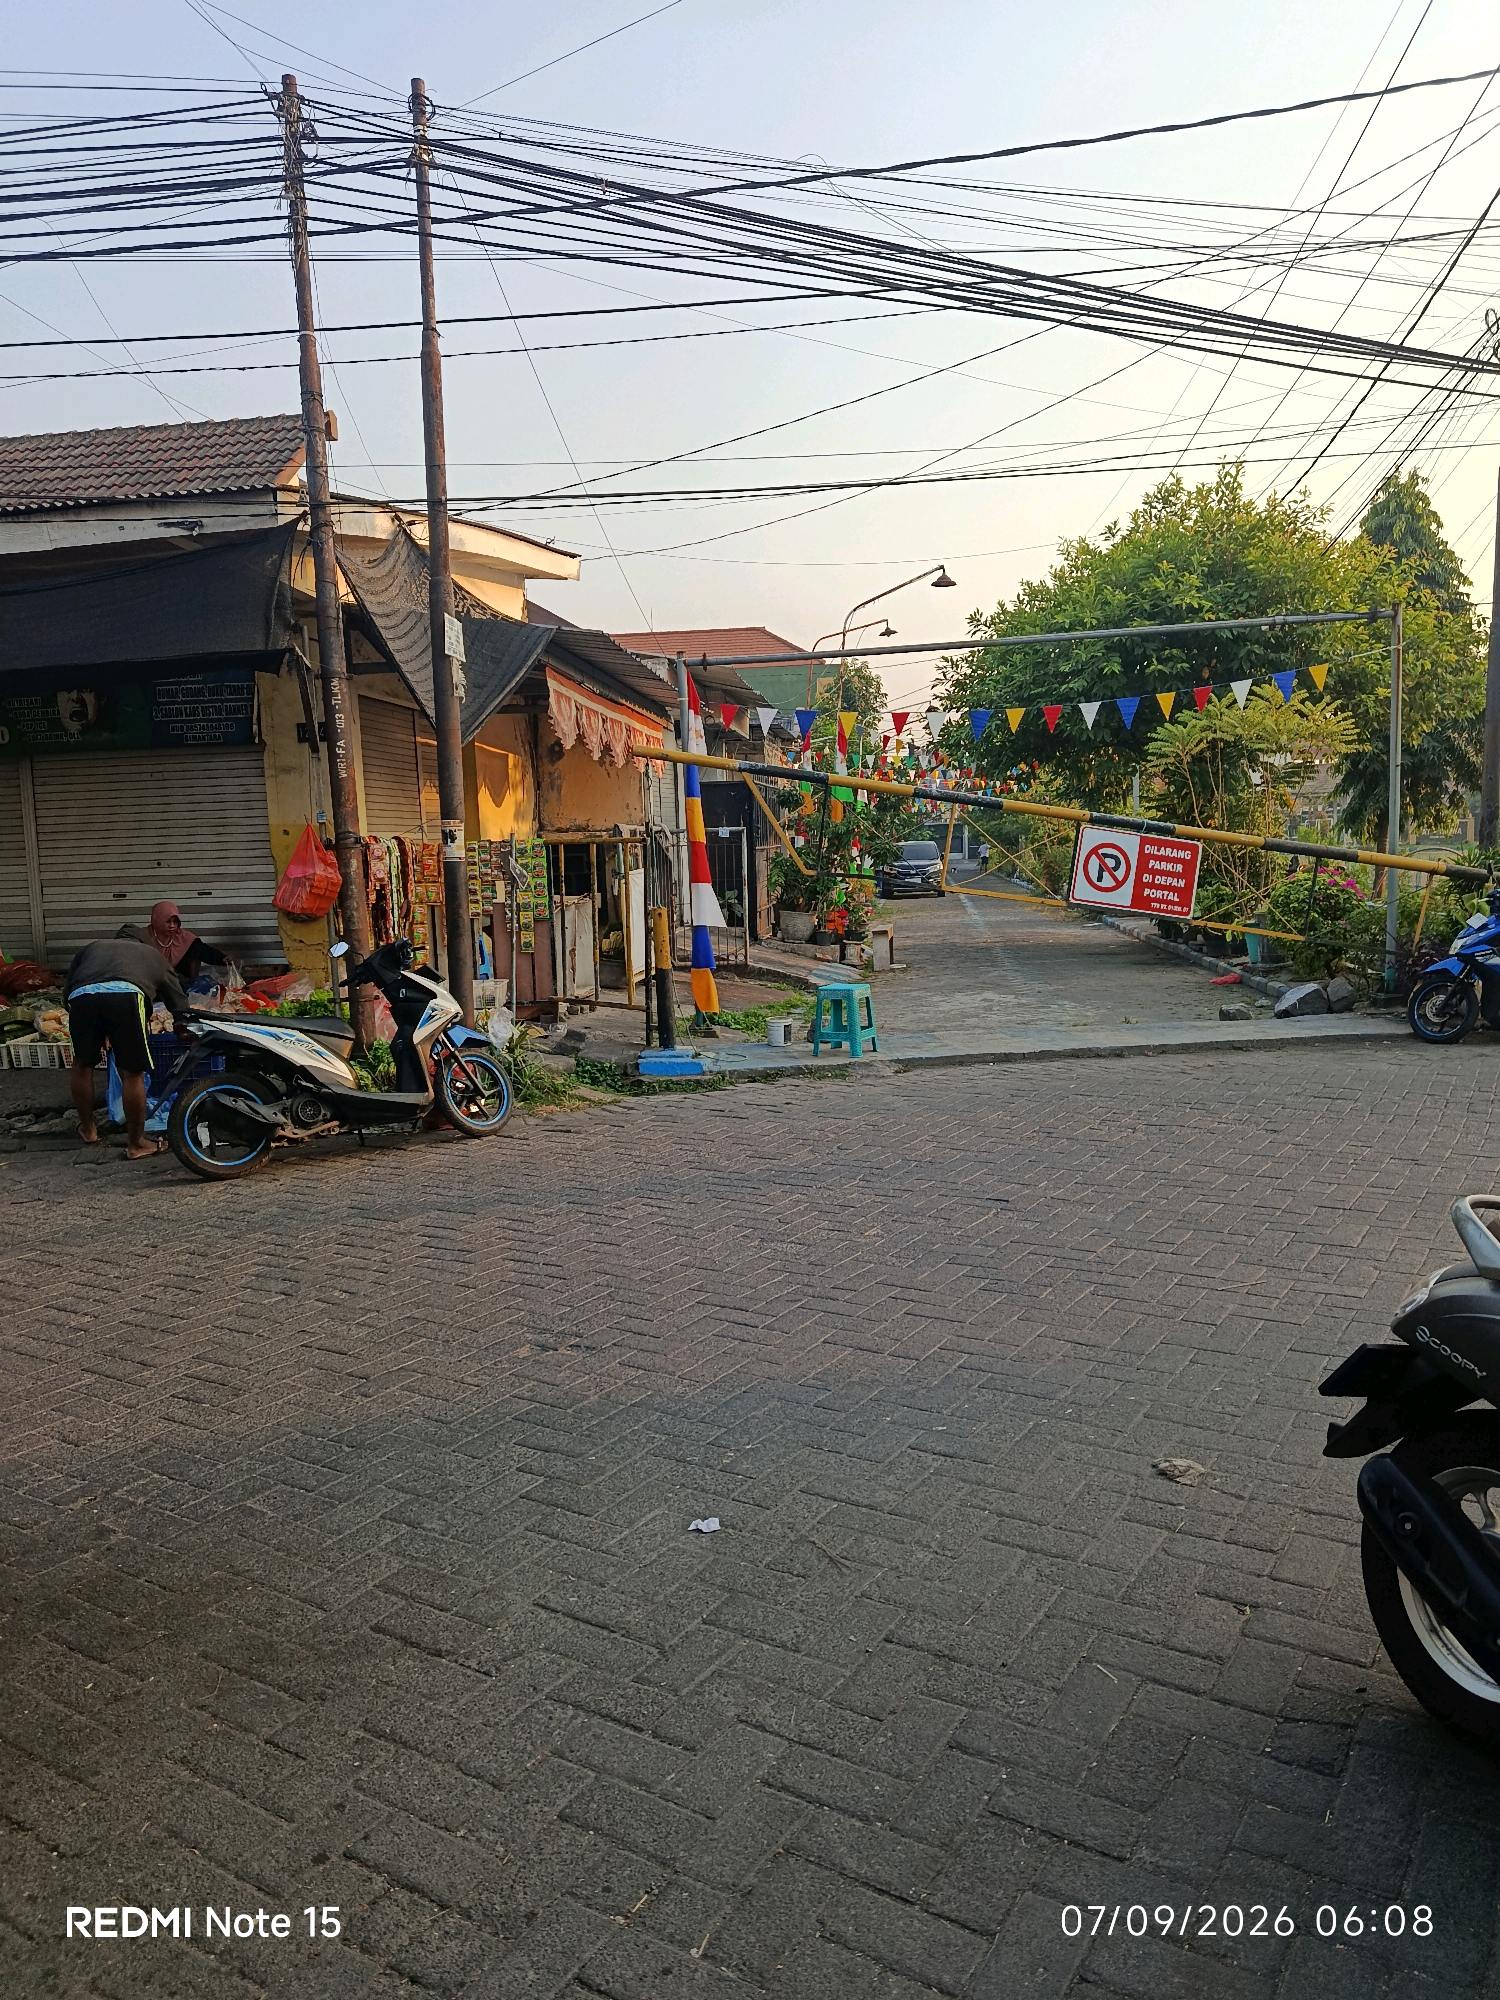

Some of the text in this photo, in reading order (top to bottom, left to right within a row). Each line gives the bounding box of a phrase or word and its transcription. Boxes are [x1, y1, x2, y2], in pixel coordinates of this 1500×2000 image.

[183, 704, 201, 720] KAOS
[1144, 844, 1191, 859] DILARANG
[1148, 860, 1183, 872] PARKIR
[1143, 874, 1185, 887] DI DEPAN
[1143, 888, 1179, 901] PORTAL
